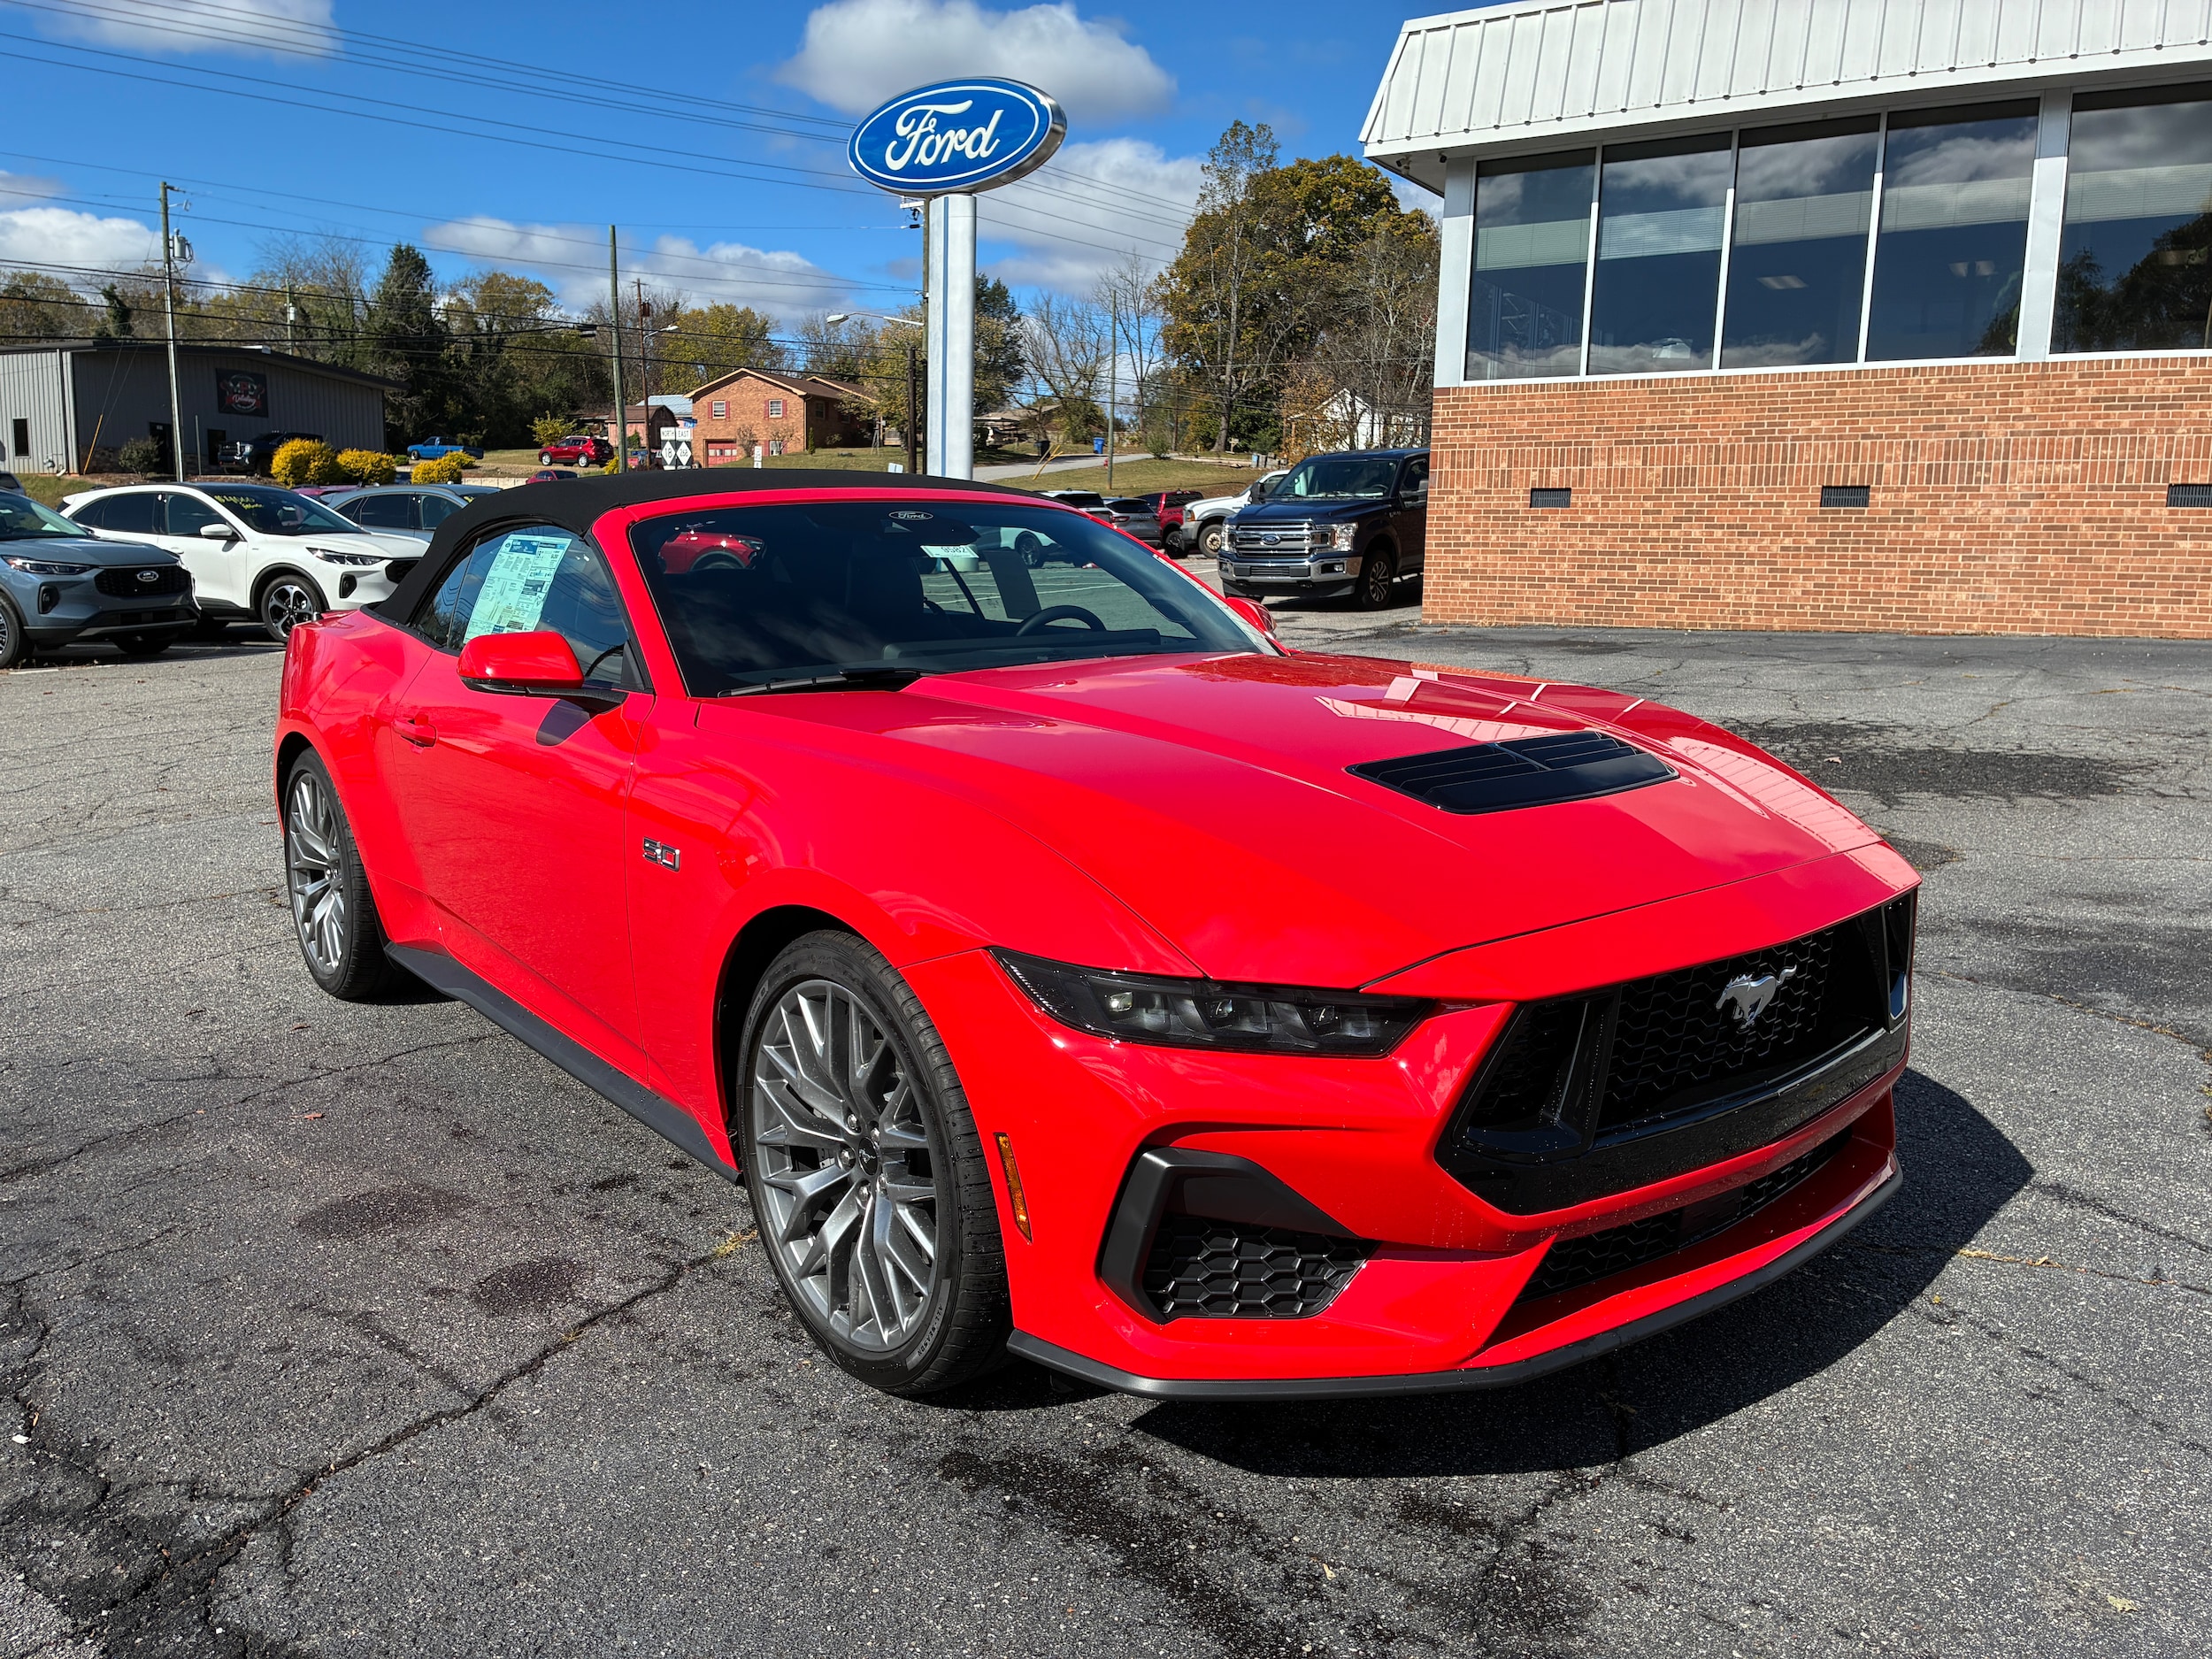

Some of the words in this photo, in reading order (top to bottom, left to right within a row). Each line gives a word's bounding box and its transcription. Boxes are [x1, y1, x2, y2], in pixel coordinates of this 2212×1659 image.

[886, 100, 1004, 171] Ford
[678, 429, 689, 438] EAST
[664, 448, 672, 458] 18
[917, 1302, 944, 1357] ALL-SEASON
